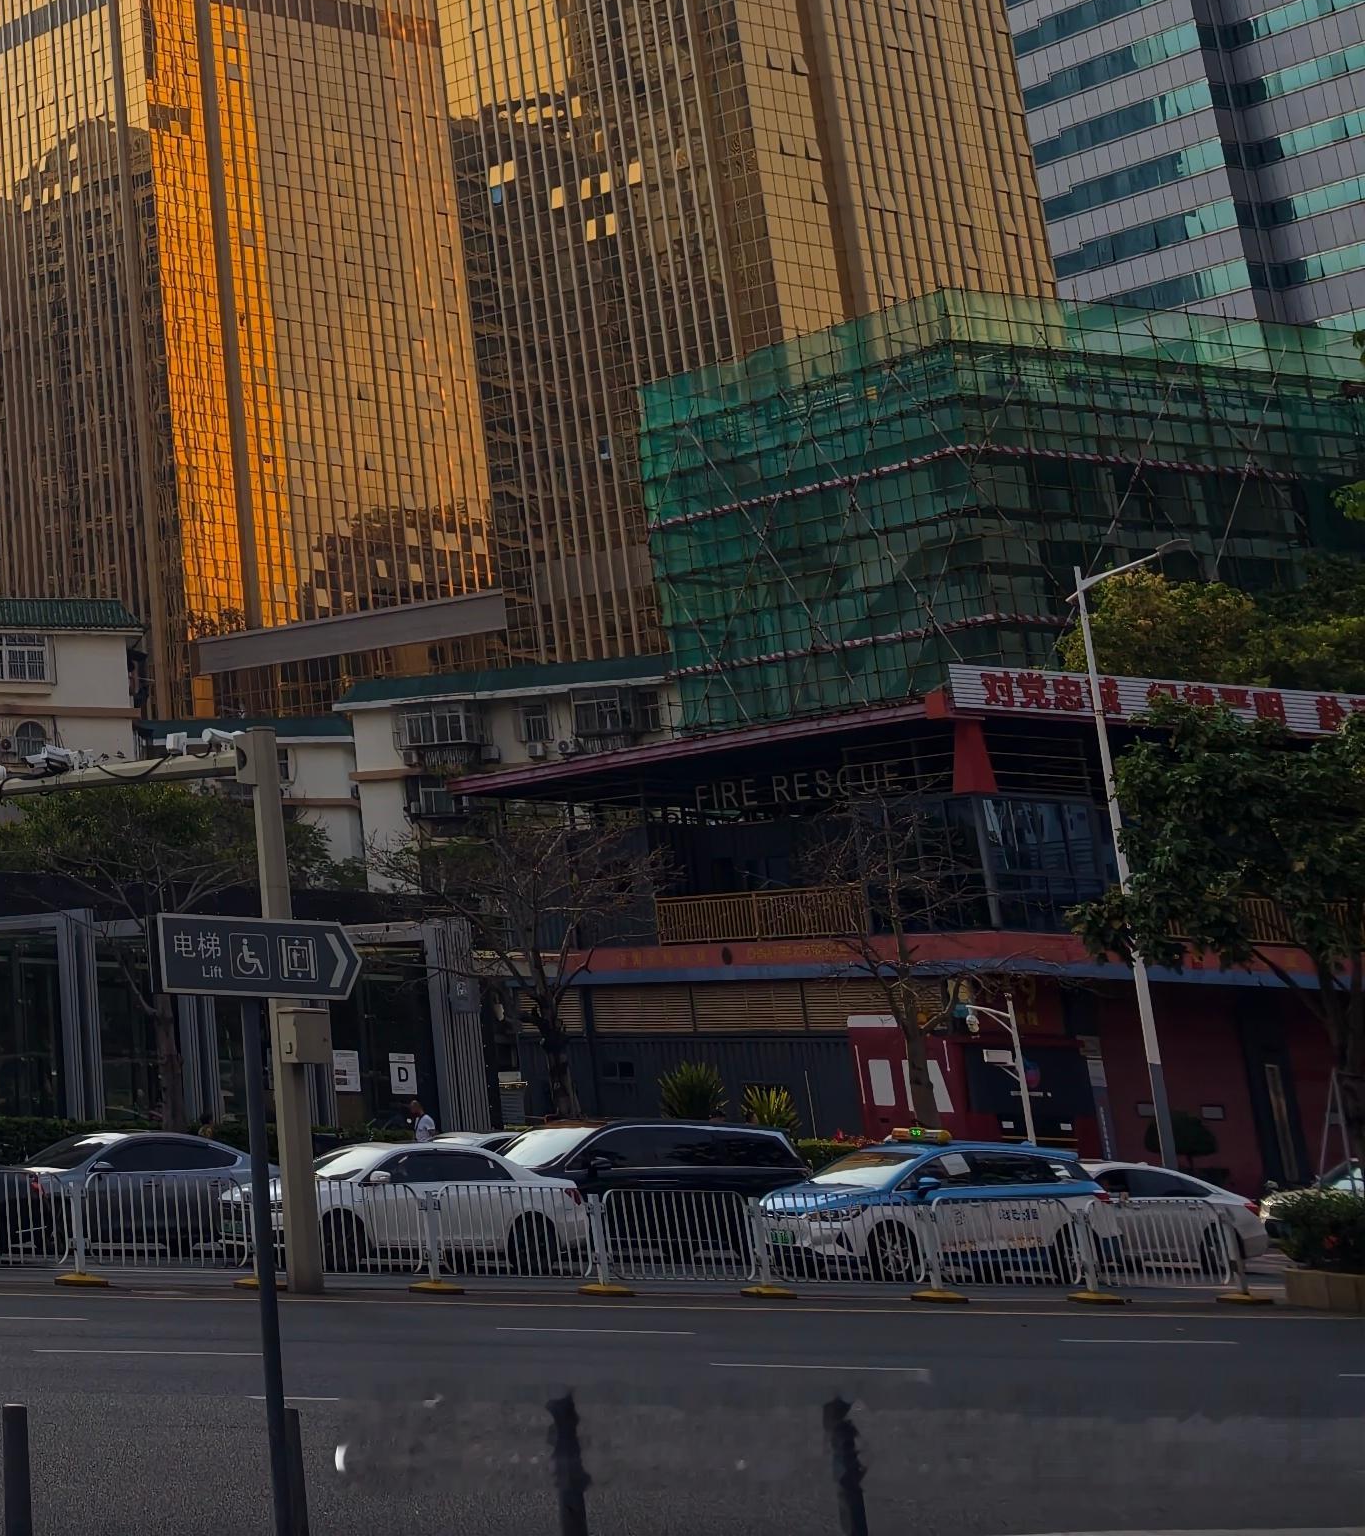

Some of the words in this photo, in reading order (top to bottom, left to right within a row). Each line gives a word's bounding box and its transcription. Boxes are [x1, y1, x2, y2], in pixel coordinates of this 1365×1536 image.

[980, 670, 1122, 714] 对党忠诚
[694, 778, 759, 813] FIRE
[771, 761, 904, 804] RESCUE
[173, 930, 222, 960] 电梯
[202, 965, 223, 979] Lift
[397, 1066, 409, 1082] D
